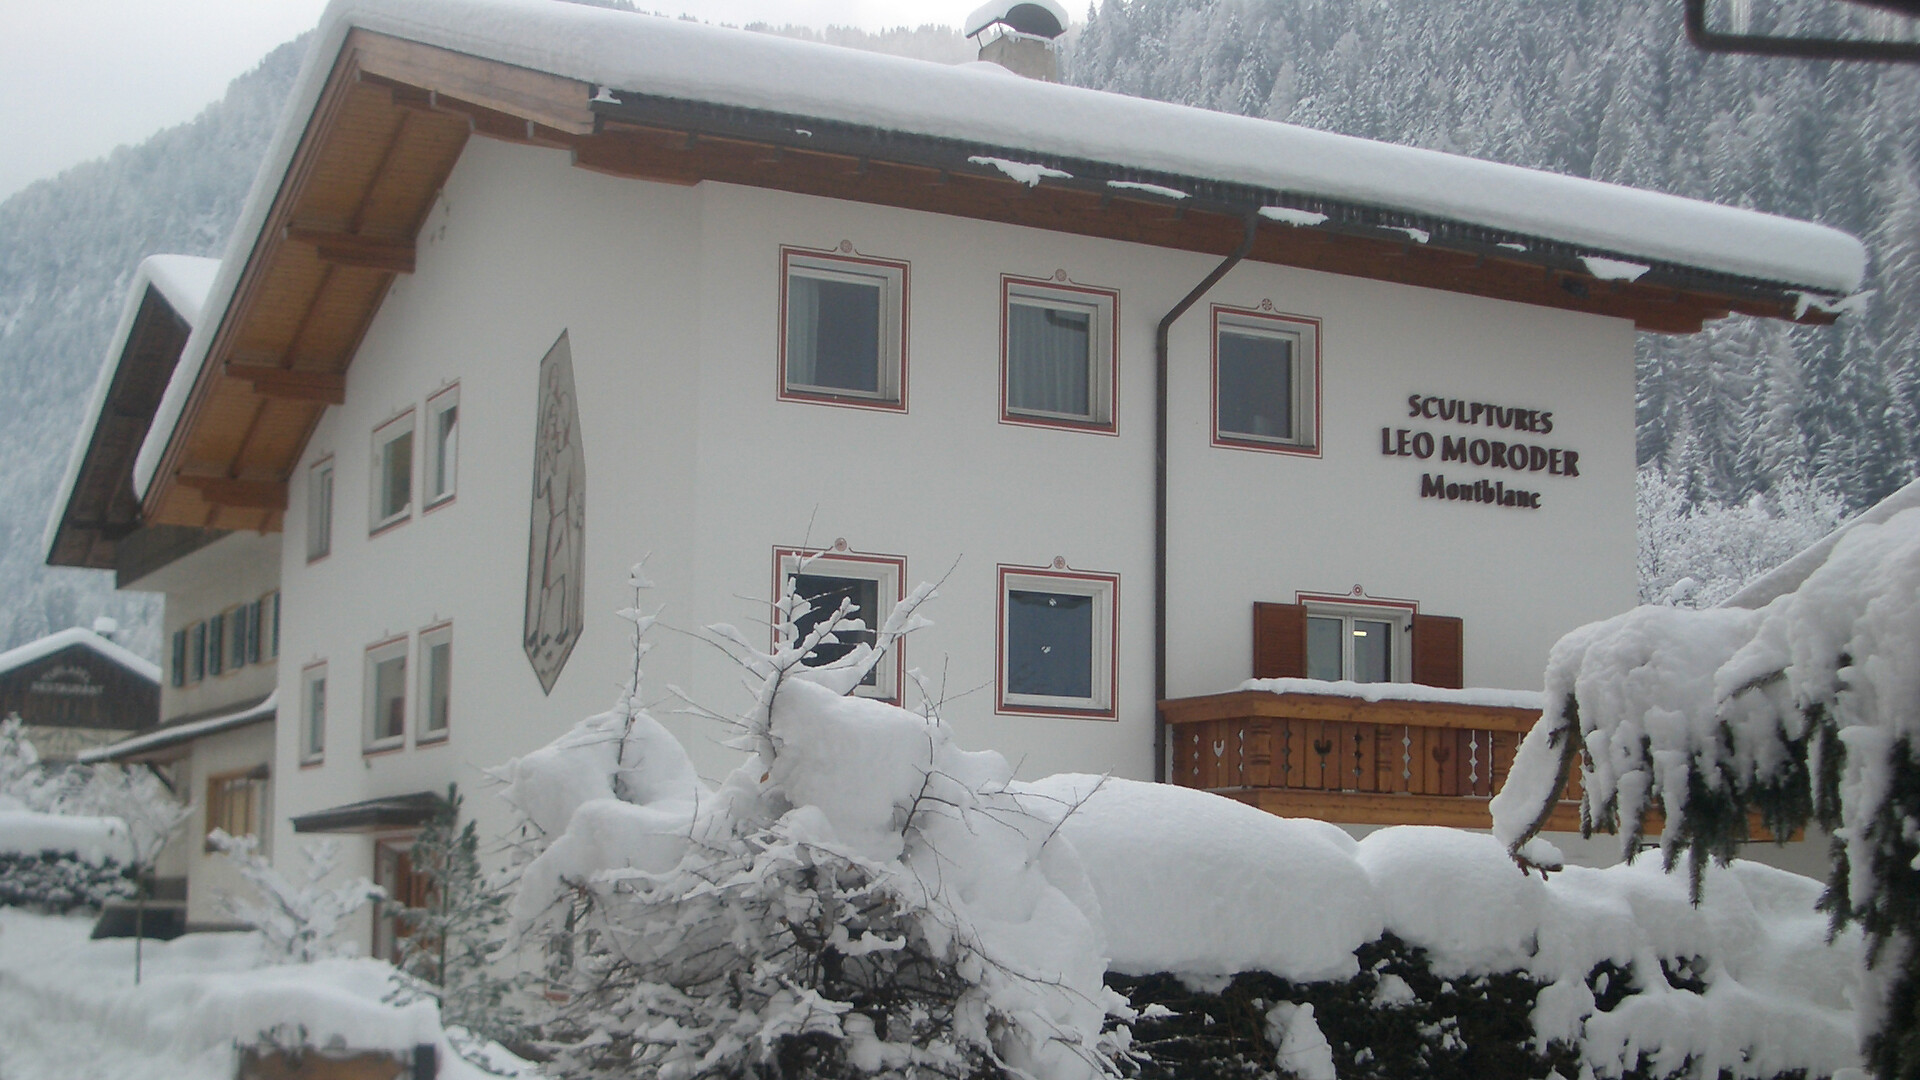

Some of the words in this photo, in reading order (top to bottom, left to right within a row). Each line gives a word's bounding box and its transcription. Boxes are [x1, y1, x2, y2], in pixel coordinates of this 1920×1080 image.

[1408, 394, 1553, 434] SCULPTURES
[1382, 427, 1435, 459] LEO
[1441, 435, 1580, 477] MORODER
[1421, 473, 1542, 509] Montblanc
